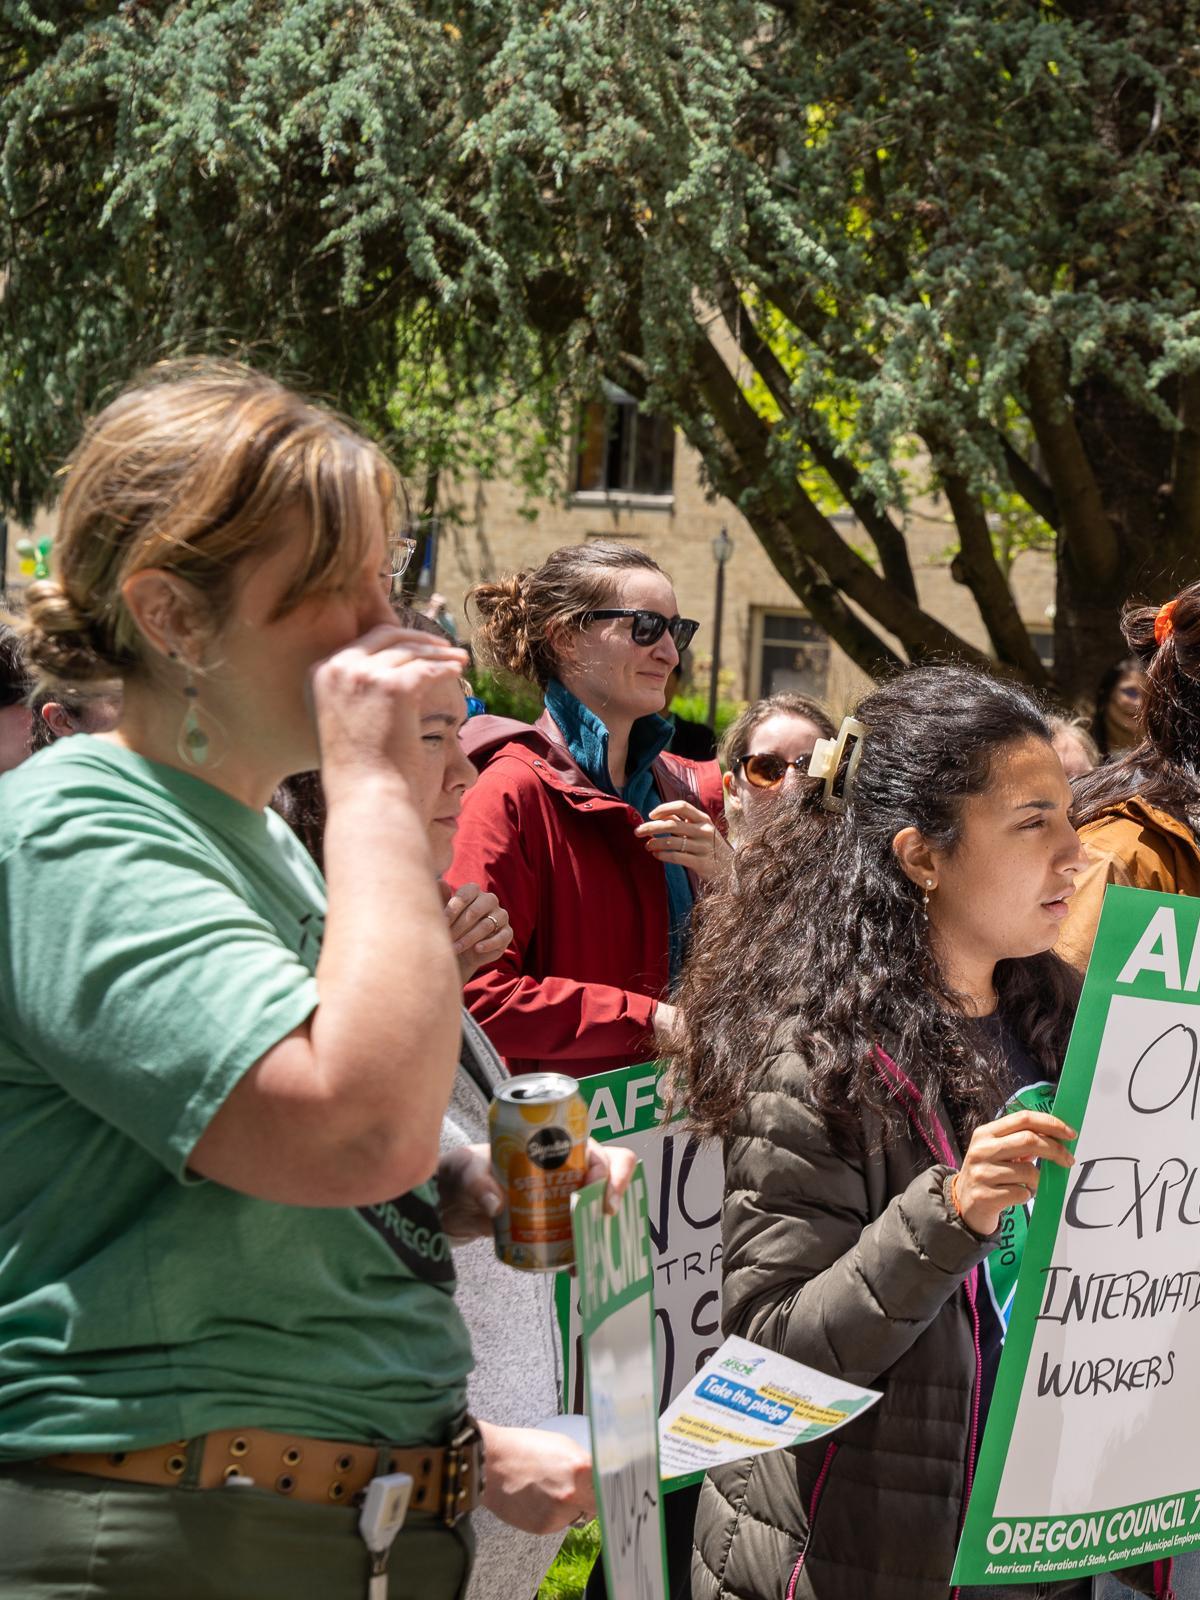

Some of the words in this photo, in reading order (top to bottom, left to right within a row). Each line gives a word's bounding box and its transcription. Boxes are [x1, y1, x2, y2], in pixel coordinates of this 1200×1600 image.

[1036, 1351, 1176, 1397] WORKERS
[703, 1376, 733, 1400] Take
[733, 1387, 750, 1407] the
[749, 1395, 789, 1421] pledge
[986, 1515, 1106, 1555] OREGON
[1105, 1497, 1186, 1544] COUNCIL
[985, 1562, 1032, 1575] American
[1032, 1557, 1078, 1572] Federation
[1078, 1554, 1088, 1568] of
[1087, 1553, 1107, 1567] State,
[1107, 1549, 1131, 1563] County
[1131, 1542, 1145, 1556] and
[1144, 1536, 1173, 1553] Municipal
